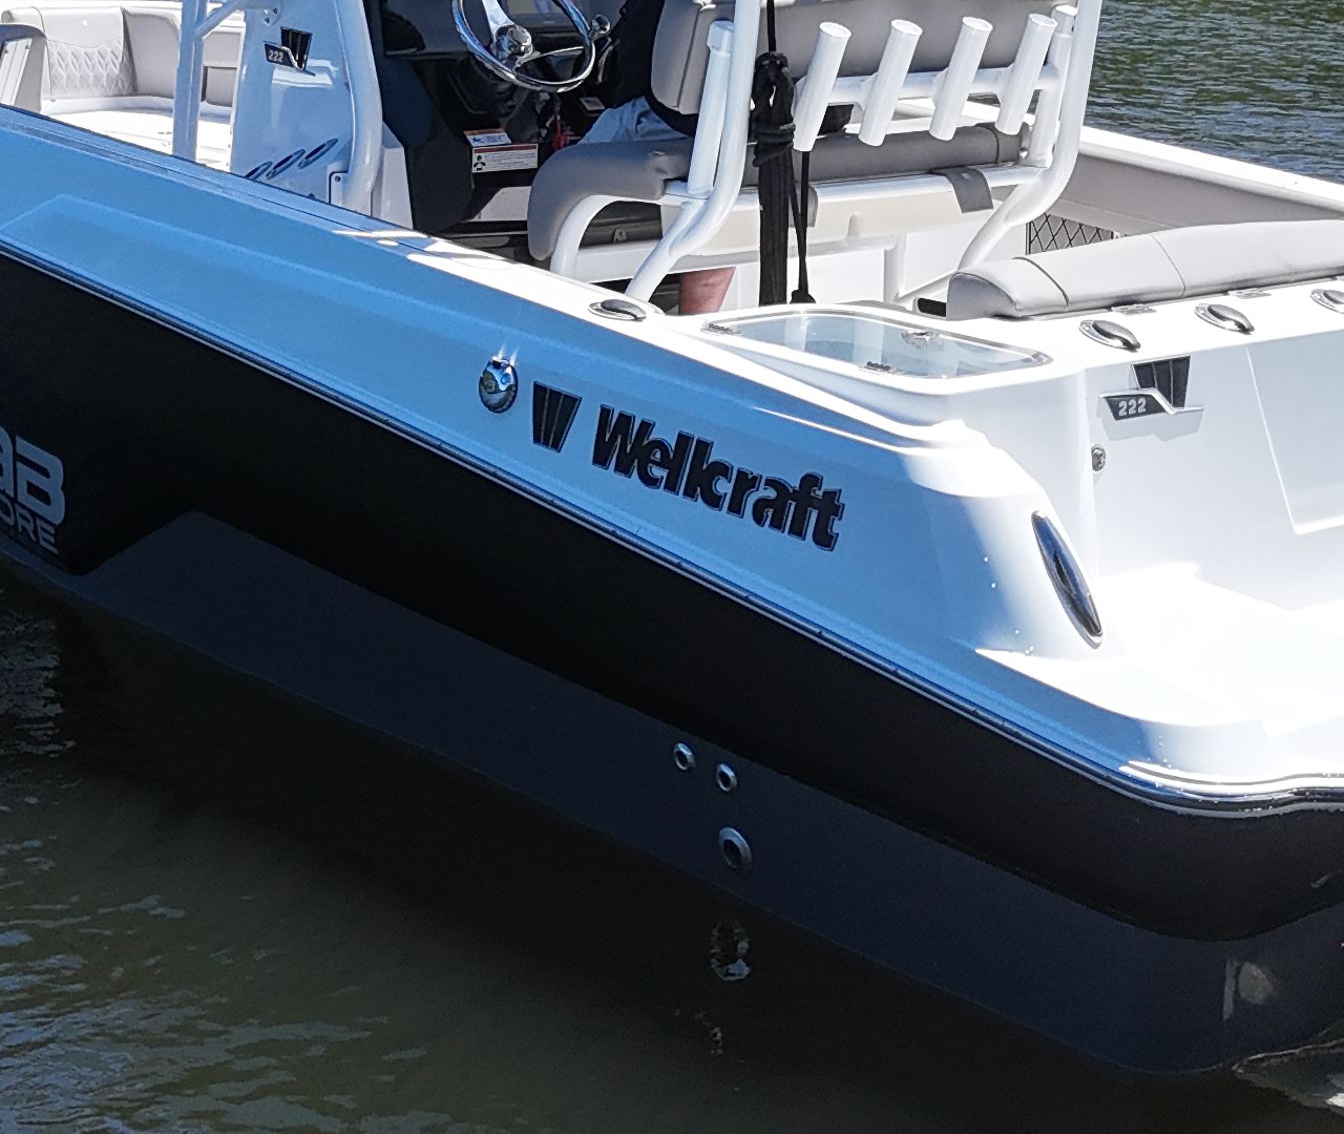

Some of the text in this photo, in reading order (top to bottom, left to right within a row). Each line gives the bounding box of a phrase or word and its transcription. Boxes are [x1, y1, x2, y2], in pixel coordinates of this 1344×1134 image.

[268, 49, 284, 63] 222
[1118, 397, 1148, 417] 222
[591, 403, 846, 552] Wellcraft
